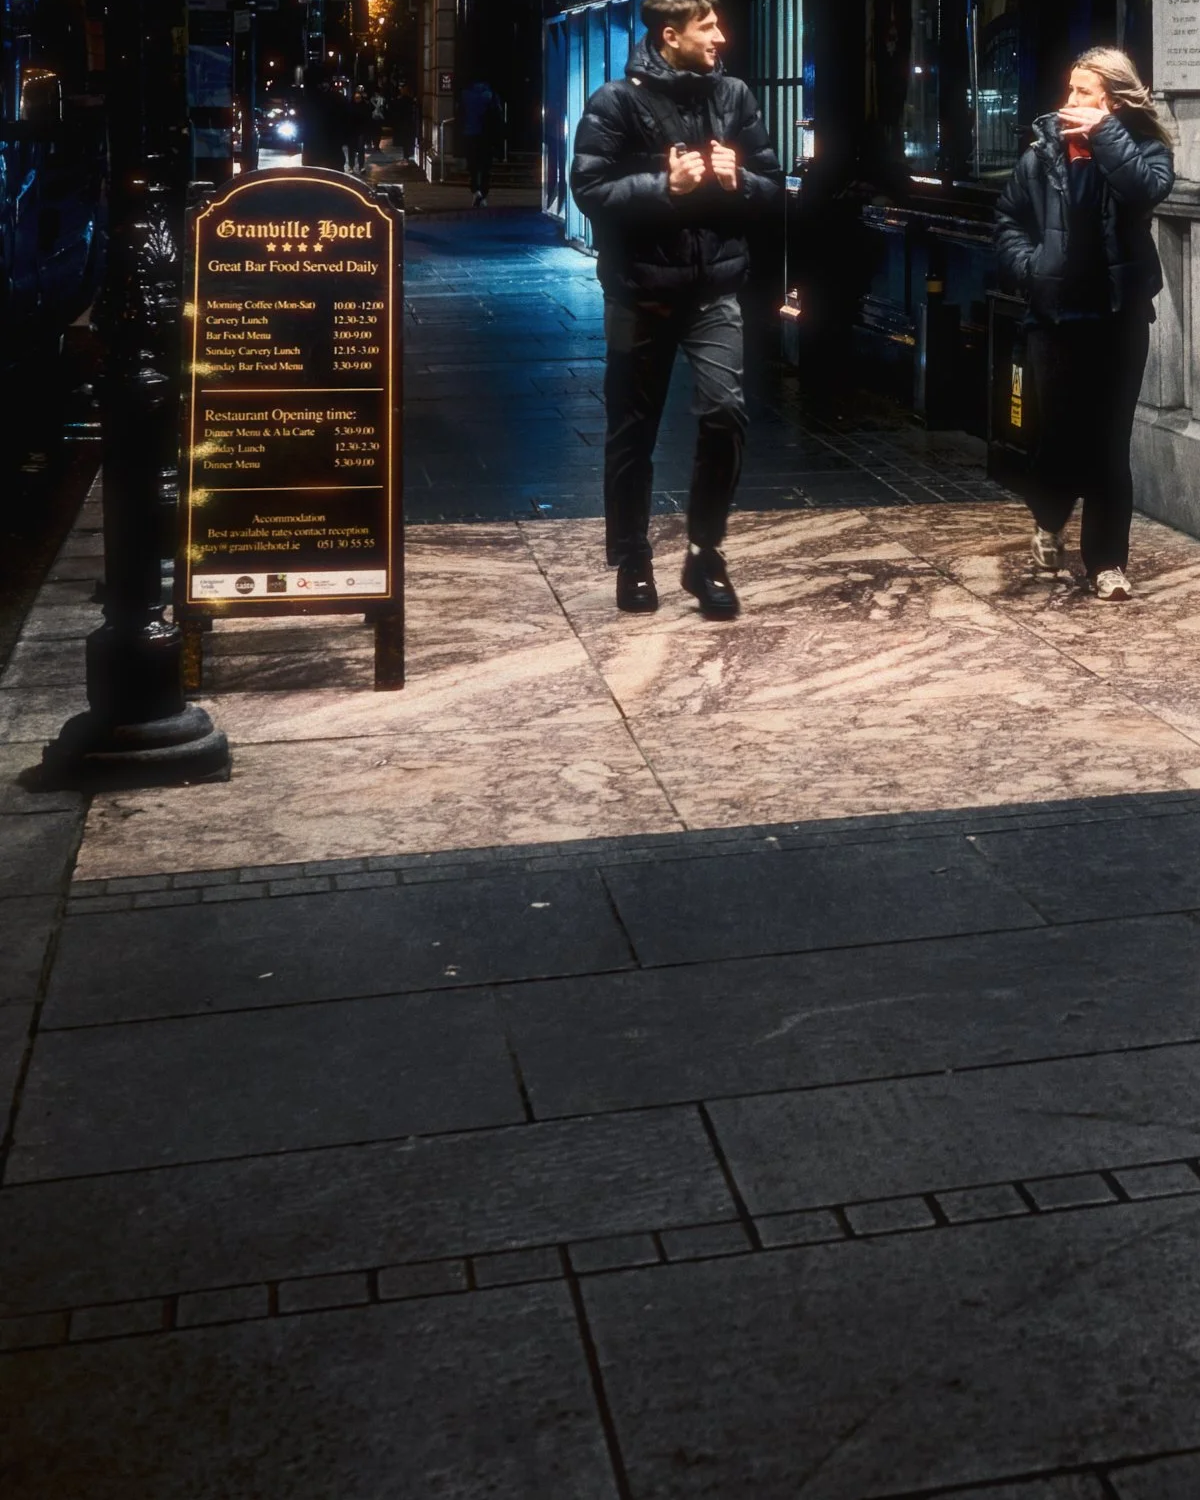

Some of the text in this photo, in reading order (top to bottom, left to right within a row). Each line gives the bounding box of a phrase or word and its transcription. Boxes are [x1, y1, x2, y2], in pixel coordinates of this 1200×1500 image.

[216, 219, 373, 241] Granville Hotel
[207, 260, 379, 275] Great Bar Food Served Daily
[207, 300, 316, 311] Morning Coffee (Mon-Sat)
[333, 302, 356, 310] 10.00
[205, 315, 269, 326] Carvery Lunch
[333, 316, 378, 325] 12.30-2.30
[206, 331, 272, 340] Bar Food Menu
[333, 331, 372, 340] 3.00-9.00
[205, 346, 301, 357] Sunday Carvery Lunch
[333, 346, 356, 355] 12.15
[238, 362, 253, 371] Bar
[255, 362, 277, 371] Food
[278, 362, 304, 371] Menu
[332, 362, 372, 370] 3.30-9.00
[204, 408, 357, 423] Restaurant Opening time:
[204, 428, 316, 437] Dinner Menu & A la Carte
[333, 426, 374, 435] 5.30-9.00
[238, 444, 266, 453] Lunch
[335, 442, 380, 451] 12.30-2.30
[203, 460, 260, 469] Dinner Menu
[334, 458, 375, 467] 5.30-9.00
[252, 513, 326, 523] Accommodation
[208, 526, 369, 538] Best available rates contact reception
[317, 540, 334, 549] 051
[337, 540, 348, 548] 30
[350, 539, 361, 548] 55
[363, 538, 375, 548] 55
